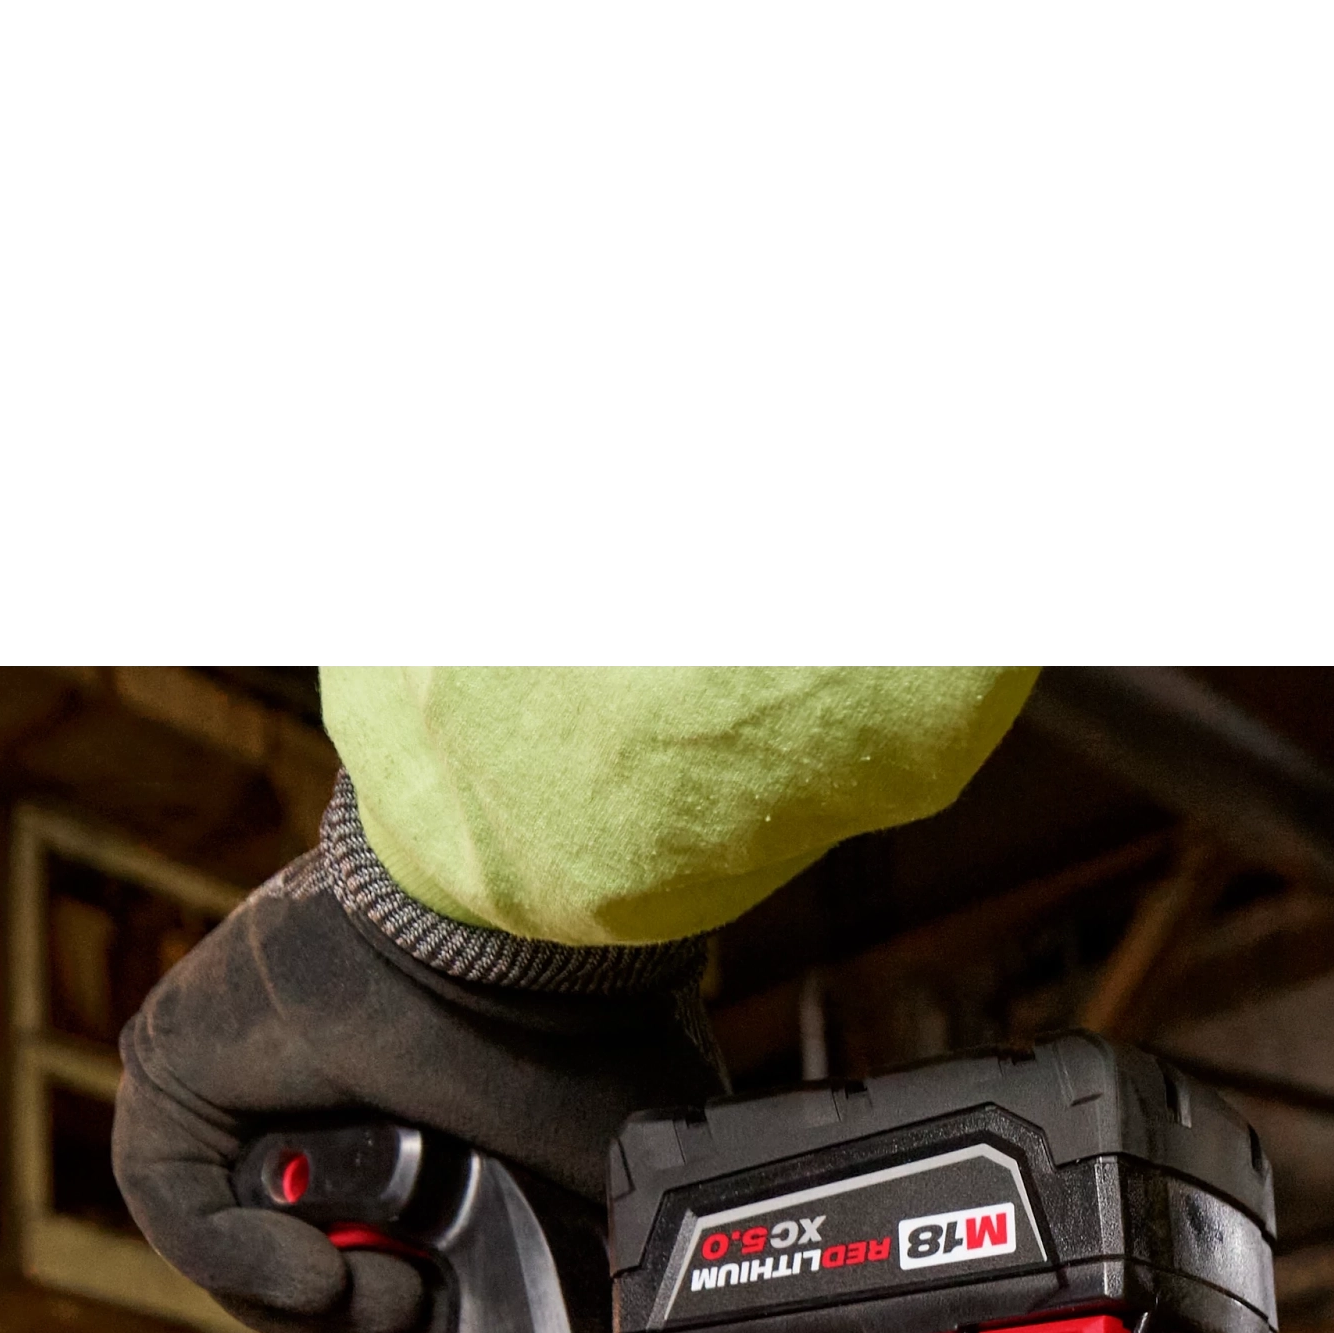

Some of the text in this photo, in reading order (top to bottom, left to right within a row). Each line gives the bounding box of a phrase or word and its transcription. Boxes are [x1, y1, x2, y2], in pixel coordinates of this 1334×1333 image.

[690, 1212, 1008, 1292] M18 REDLITHIUM
[701, 1215, 827, 1261] XC5.0
